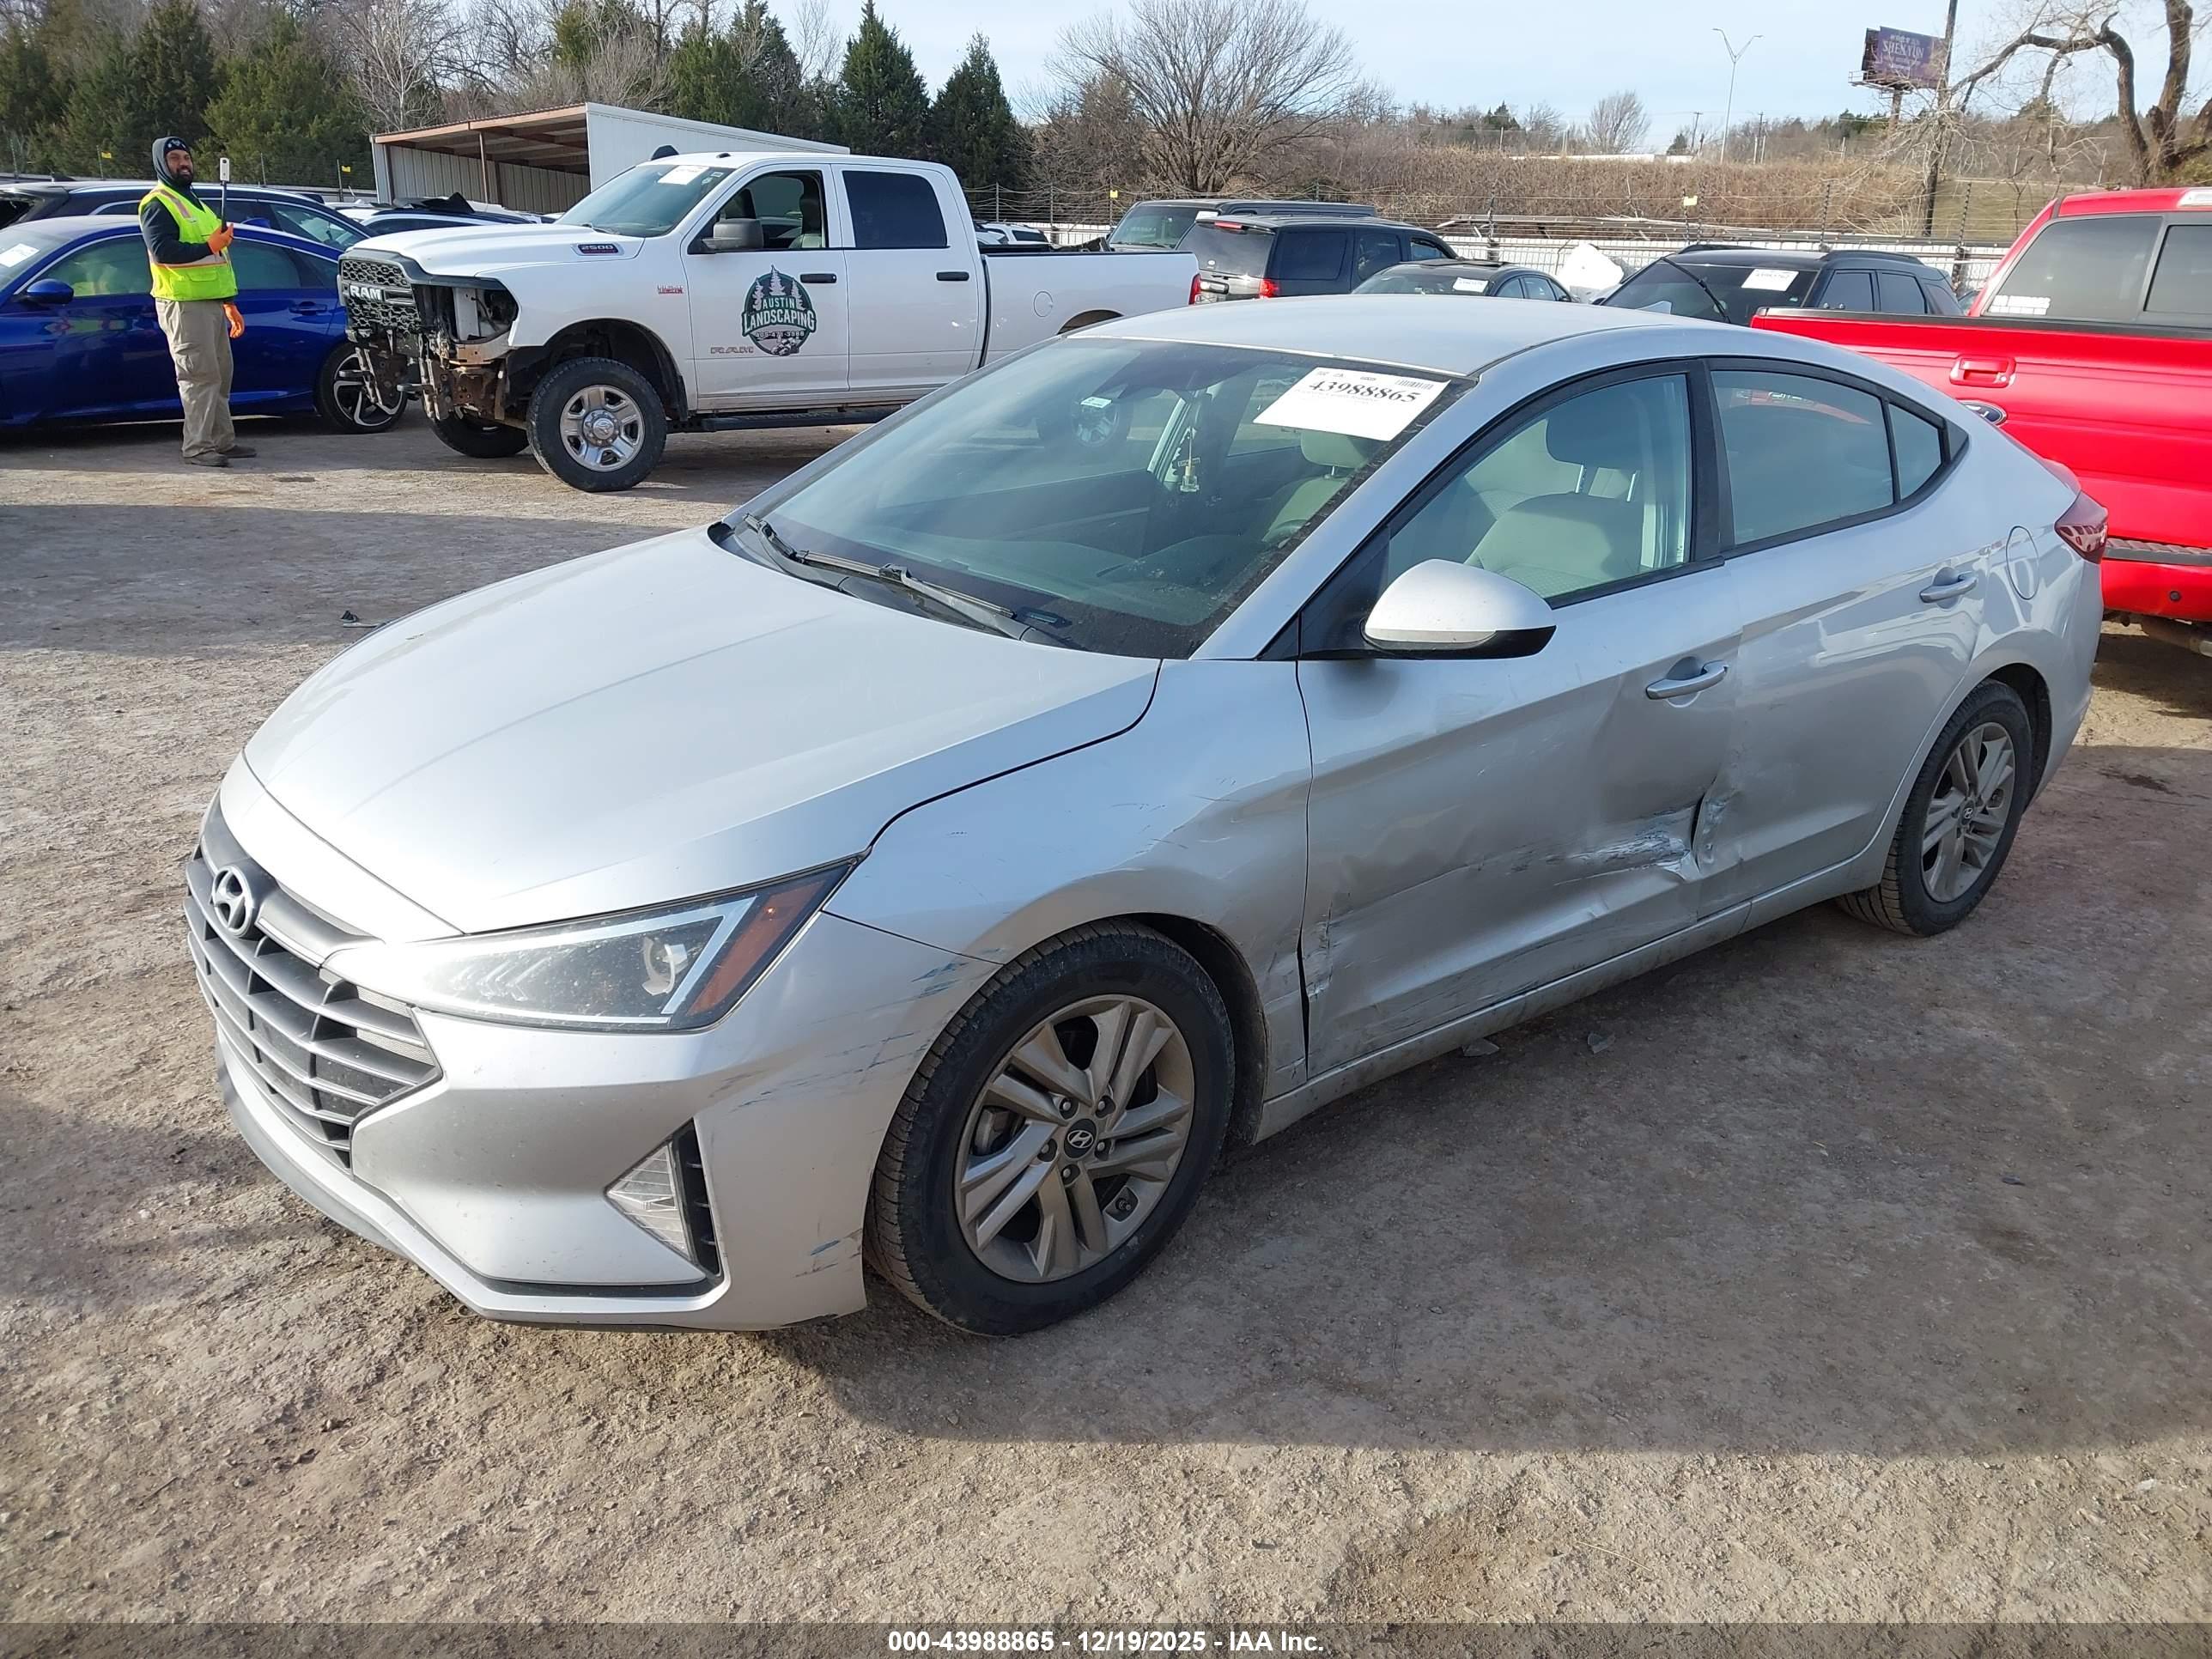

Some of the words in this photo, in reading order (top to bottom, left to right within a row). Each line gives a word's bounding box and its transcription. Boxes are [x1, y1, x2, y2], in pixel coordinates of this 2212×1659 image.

[349, 285, 382, 301] RAM
[763, 297, 795, 309] AUSTIN
[744, 309, 815, 332] LANDSCAPING
[1310, 380, 1420, 403] 43988865
